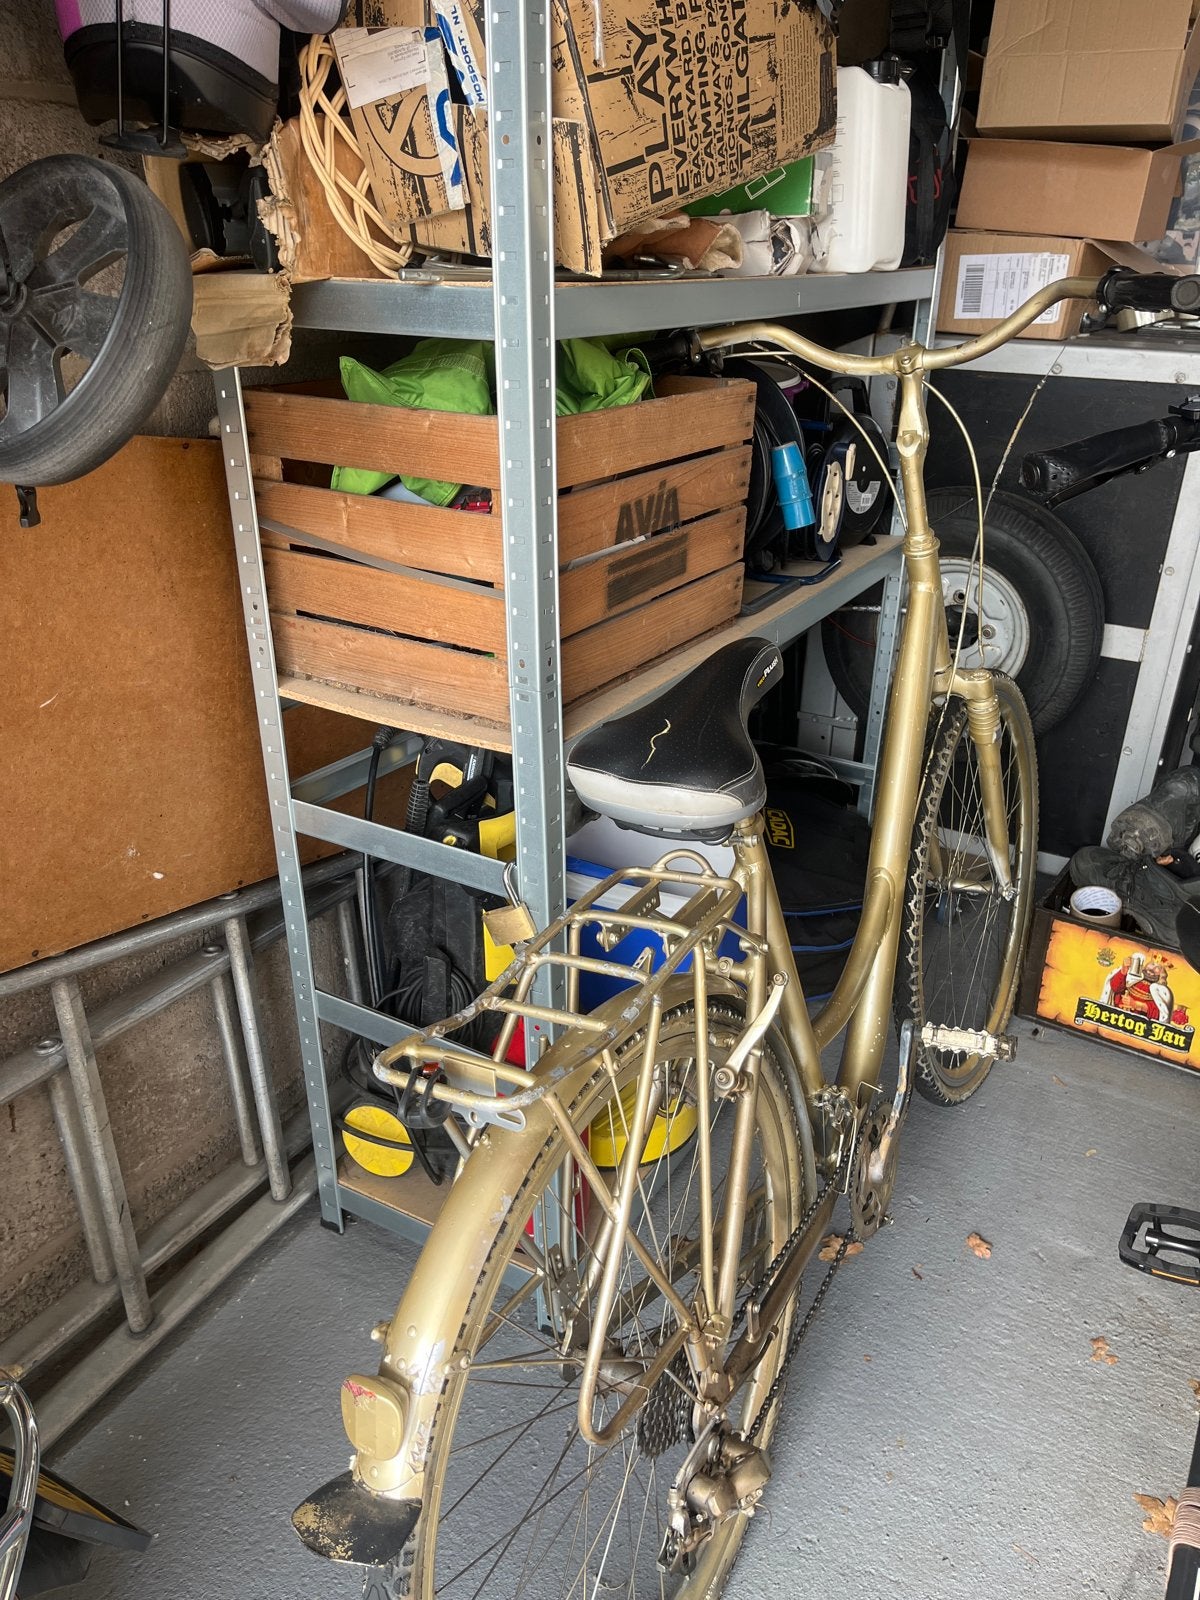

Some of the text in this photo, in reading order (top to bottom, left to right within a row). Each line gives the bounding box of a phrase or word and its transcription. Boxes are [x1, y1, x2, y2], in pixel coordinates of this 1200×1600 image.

[626, 17, 674, 204] PLAY
[682, 28, 702, 189] BACKYARD,
[695, 24, 715, 183] CAMPING,
[711, 35, 726, 177] HALLWAYS,
[766, 809, 791, 846] CADAC
[1083, 1000, 1186, 1048] Hertog Jan
